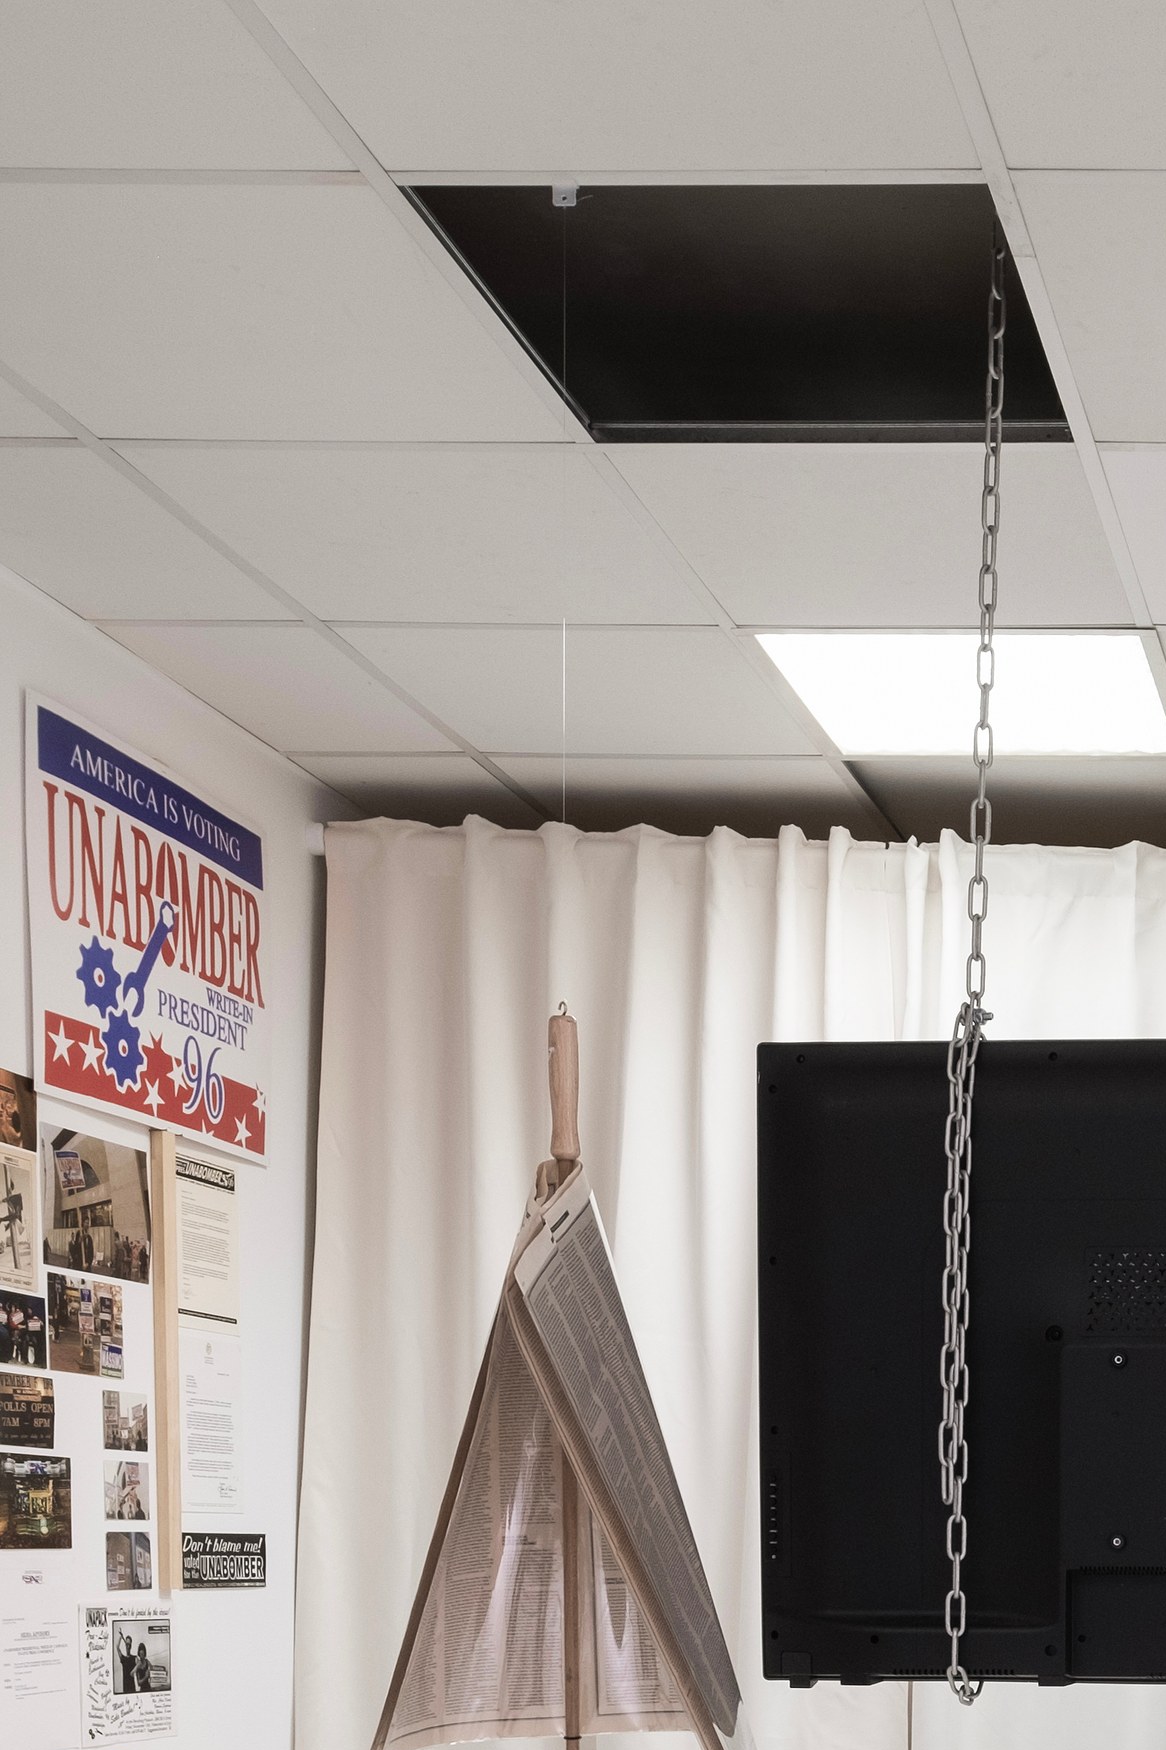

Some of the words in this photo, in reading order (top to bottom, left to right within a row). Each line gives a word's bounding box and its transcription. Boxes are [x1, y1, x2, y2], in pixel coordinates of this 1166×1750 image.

[70, 744, 159, 814] AMERICA
[163, 794, 179, 825] IS
[182, 804, 241, 862] VOTING
[42, 780, 265, 1010] UNABOMBER
[157, 988, 248, 1052] PRESIDENT
[206, 987, 254, 1025] WRITE-IN
[2, 1417, 20, 1427] 7AM
[33, 1418, 50, 1428] 8PM
[31, 1403, 54, 1413] OPEN
[183, 1536, 212, 1552] Don't
[213, 1537, 241, 1553] blame
[243, 1537, 263, 1553] me!
[200, 1554, 265, 1580] UNABOMBER
